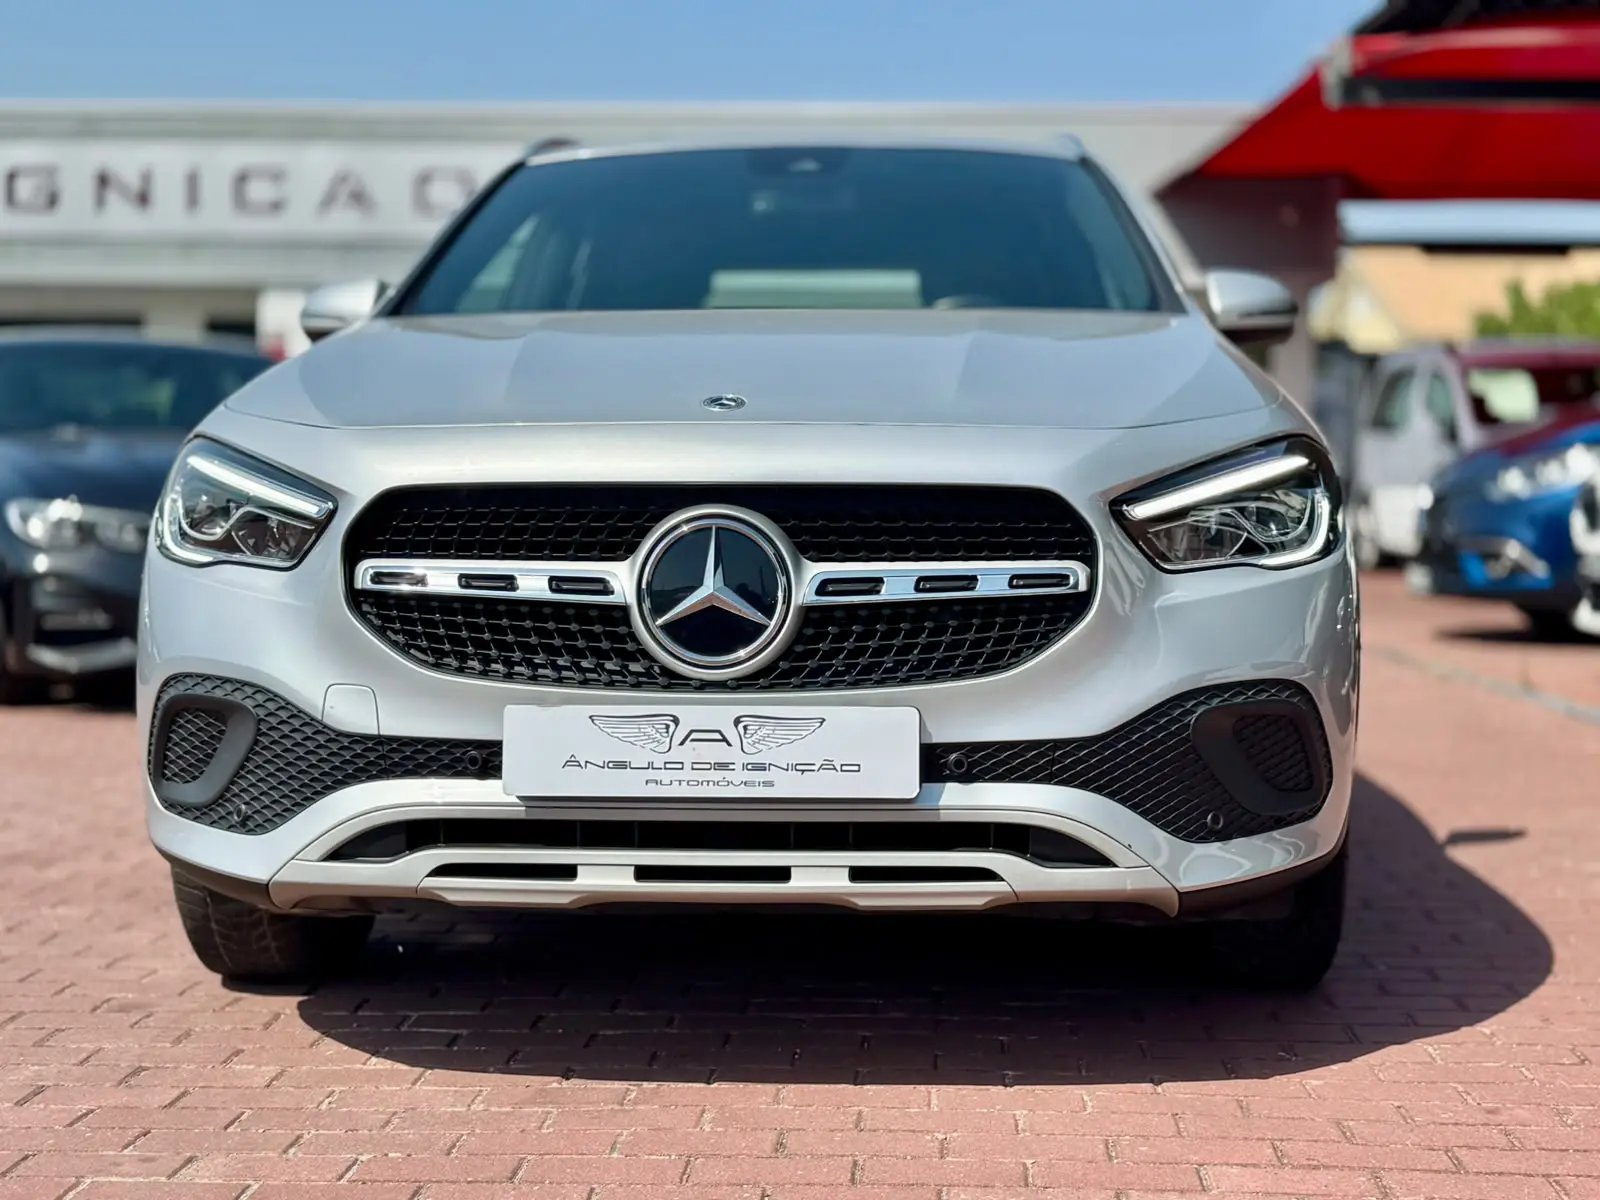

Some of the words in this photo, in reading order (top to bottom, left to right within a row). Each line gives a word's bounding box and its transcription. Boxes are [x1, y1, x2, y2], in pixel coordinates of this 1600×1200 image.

[677, 728, 733, 747] A
[561, 753, 685, 771] ÂNGULO
[690, 761, 737, 772] DE
[741, 758, 862, 776] IGNIÇÃO
[644, 776, 776, 788] AUTOMÓVEIS
